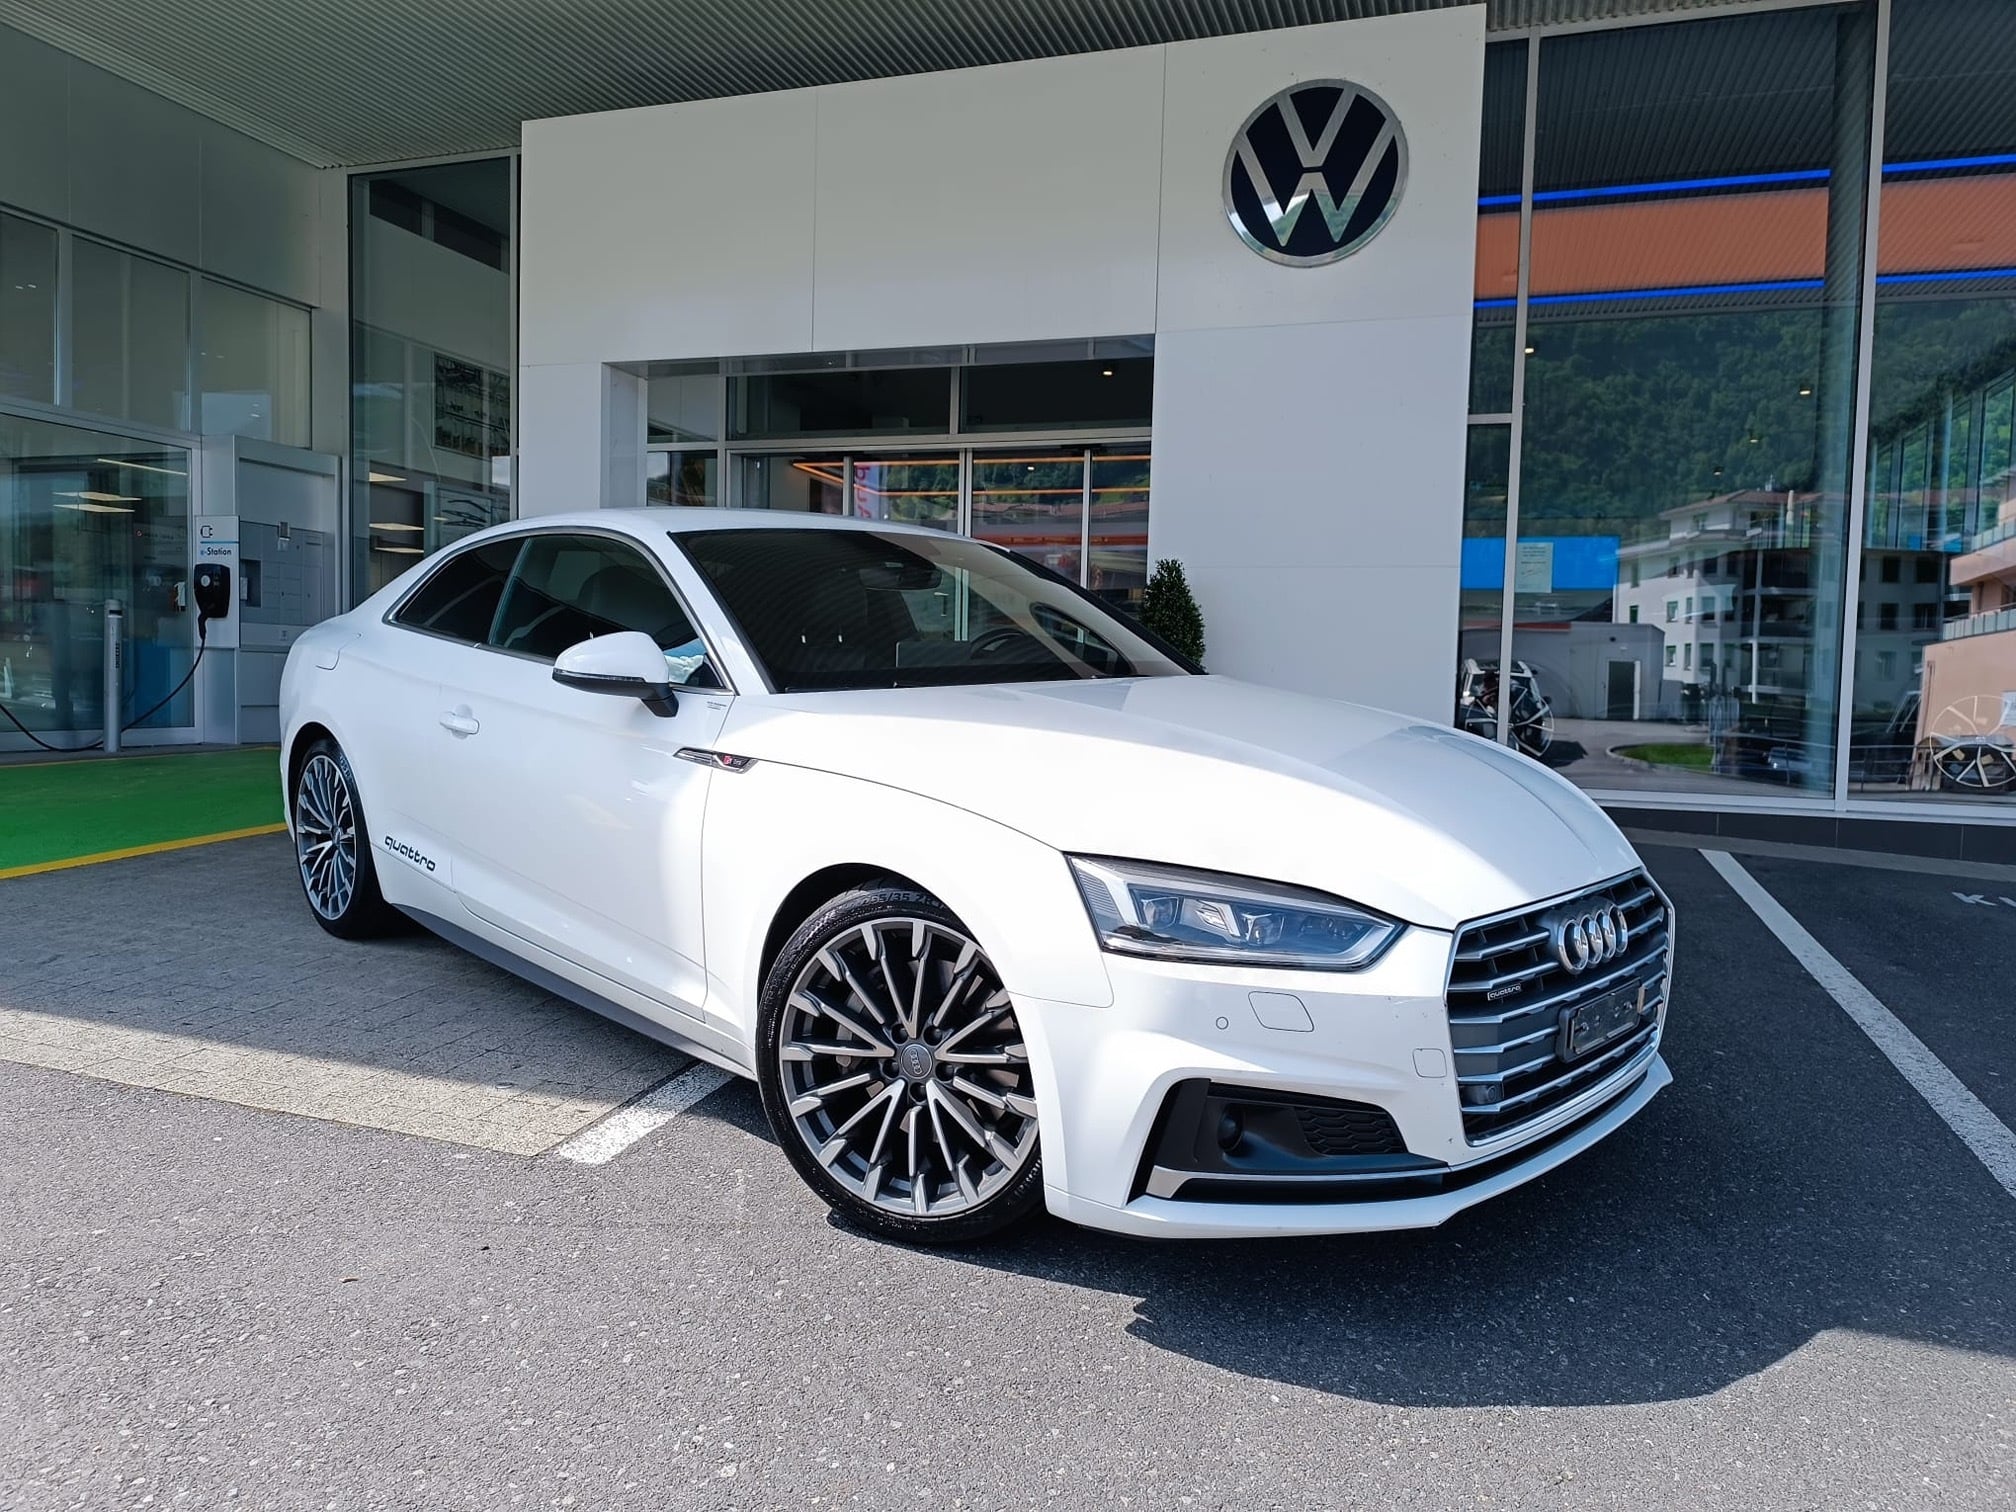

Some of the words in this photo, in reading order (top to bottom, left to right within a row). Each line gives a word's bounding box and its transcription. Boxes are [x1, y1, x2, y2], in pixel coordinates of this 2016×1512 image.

[200, 546, 232, 556] e-Station
[384, 835, 436, 872] quattro
[1490, 985, 1521, 998] quattro
